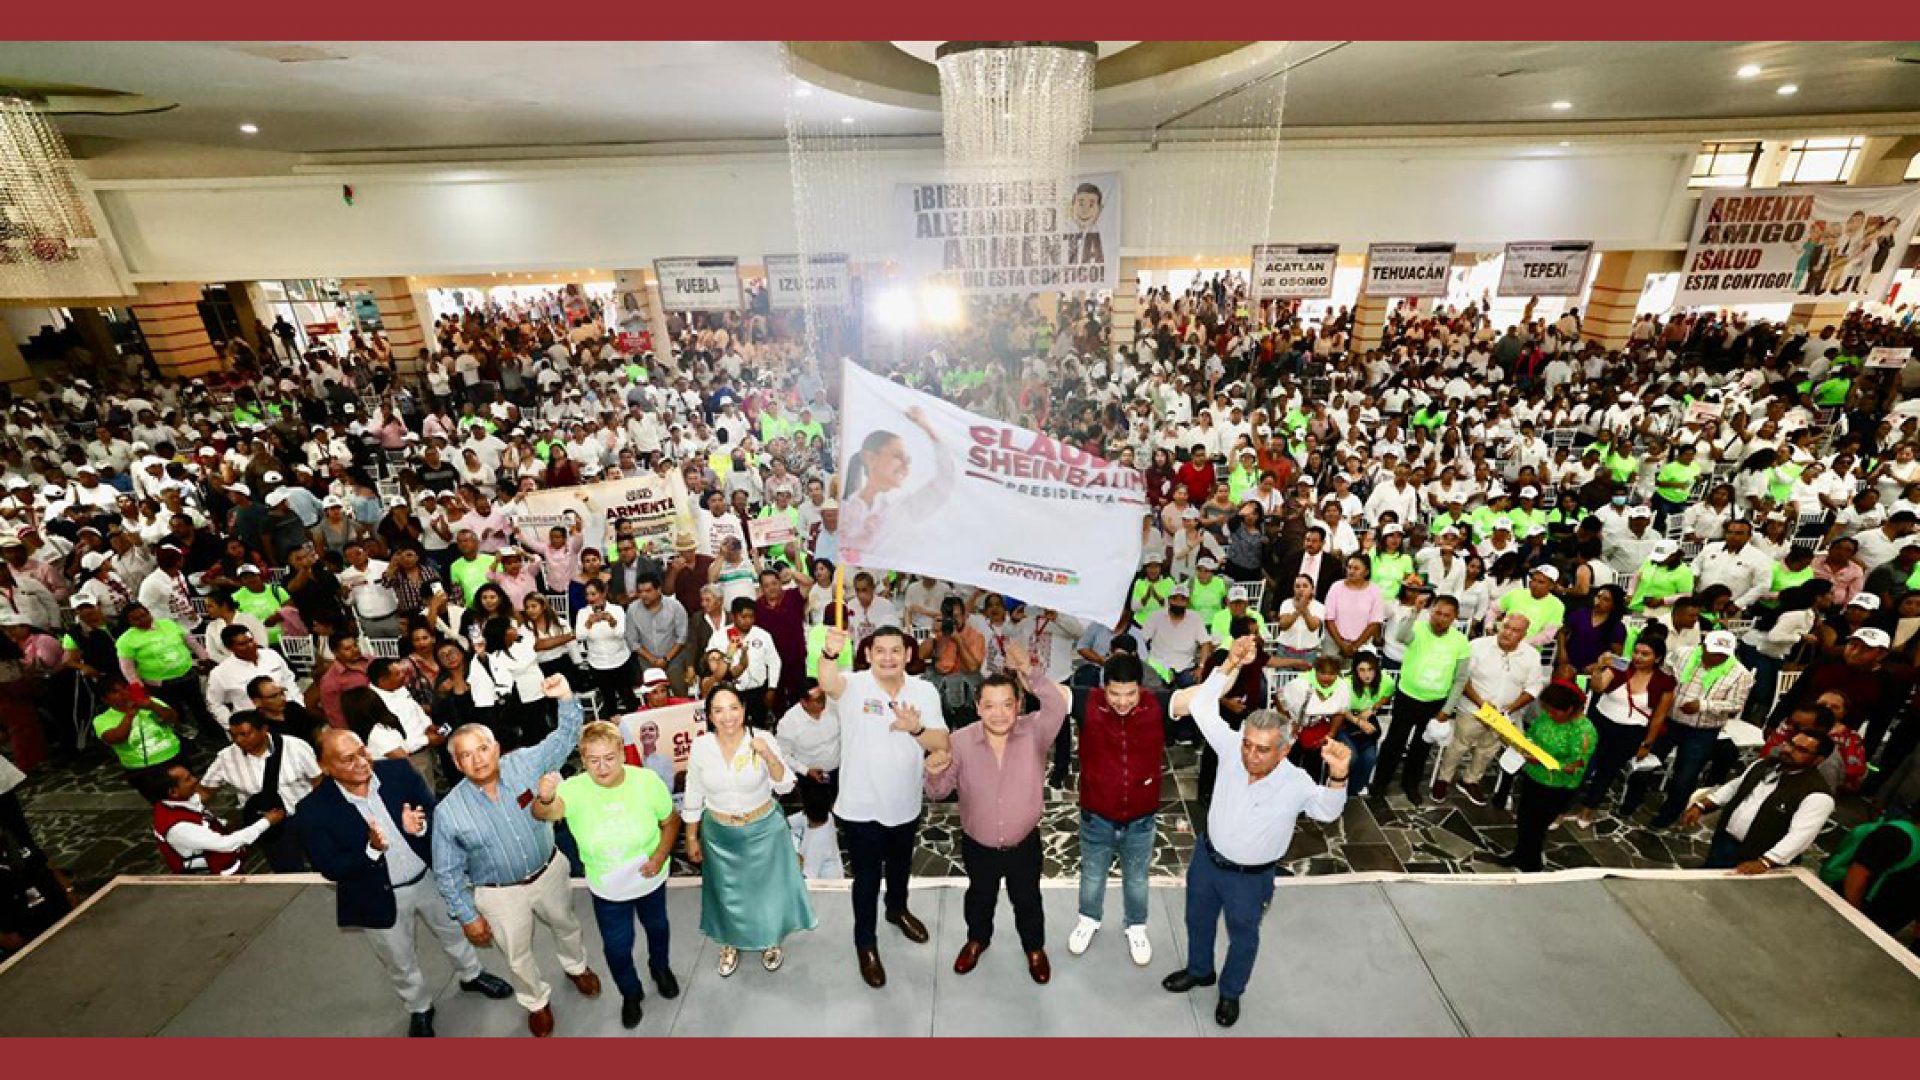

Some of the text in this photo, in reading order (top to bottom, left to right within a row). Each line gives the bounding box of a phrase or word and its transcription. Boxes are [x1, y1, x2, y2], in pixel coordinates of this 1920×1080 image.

[1708, 195, 1815, 222] ARMENTA
[1700, 222, 1806, 244] AMIGO
[943, 232, 1105, 270] ARMENTA
[1691, 249, 1762, 273] ¡SALUD
[988, 268, 1026, 287] ESTA
[1029, 266, 1105, 286] CONTIGO!
[1372, 262, 1445, 280] TEHUACÁN
[1523, 262, 1568, 278] TEPEXI
[676, 277, 720, 294] PUEBLA
[779, 275, 836, 292] IZUCAR
[1280, 276, 1328, 287] OSORIO
[1684, 272, 1793, 291] ESTA CONTIGO!
[1006, 481, 1115, 504] PRESIDENTA
[607, 497, 675, 519] ARMENTA
[988, 562, 1055, 583] morena
